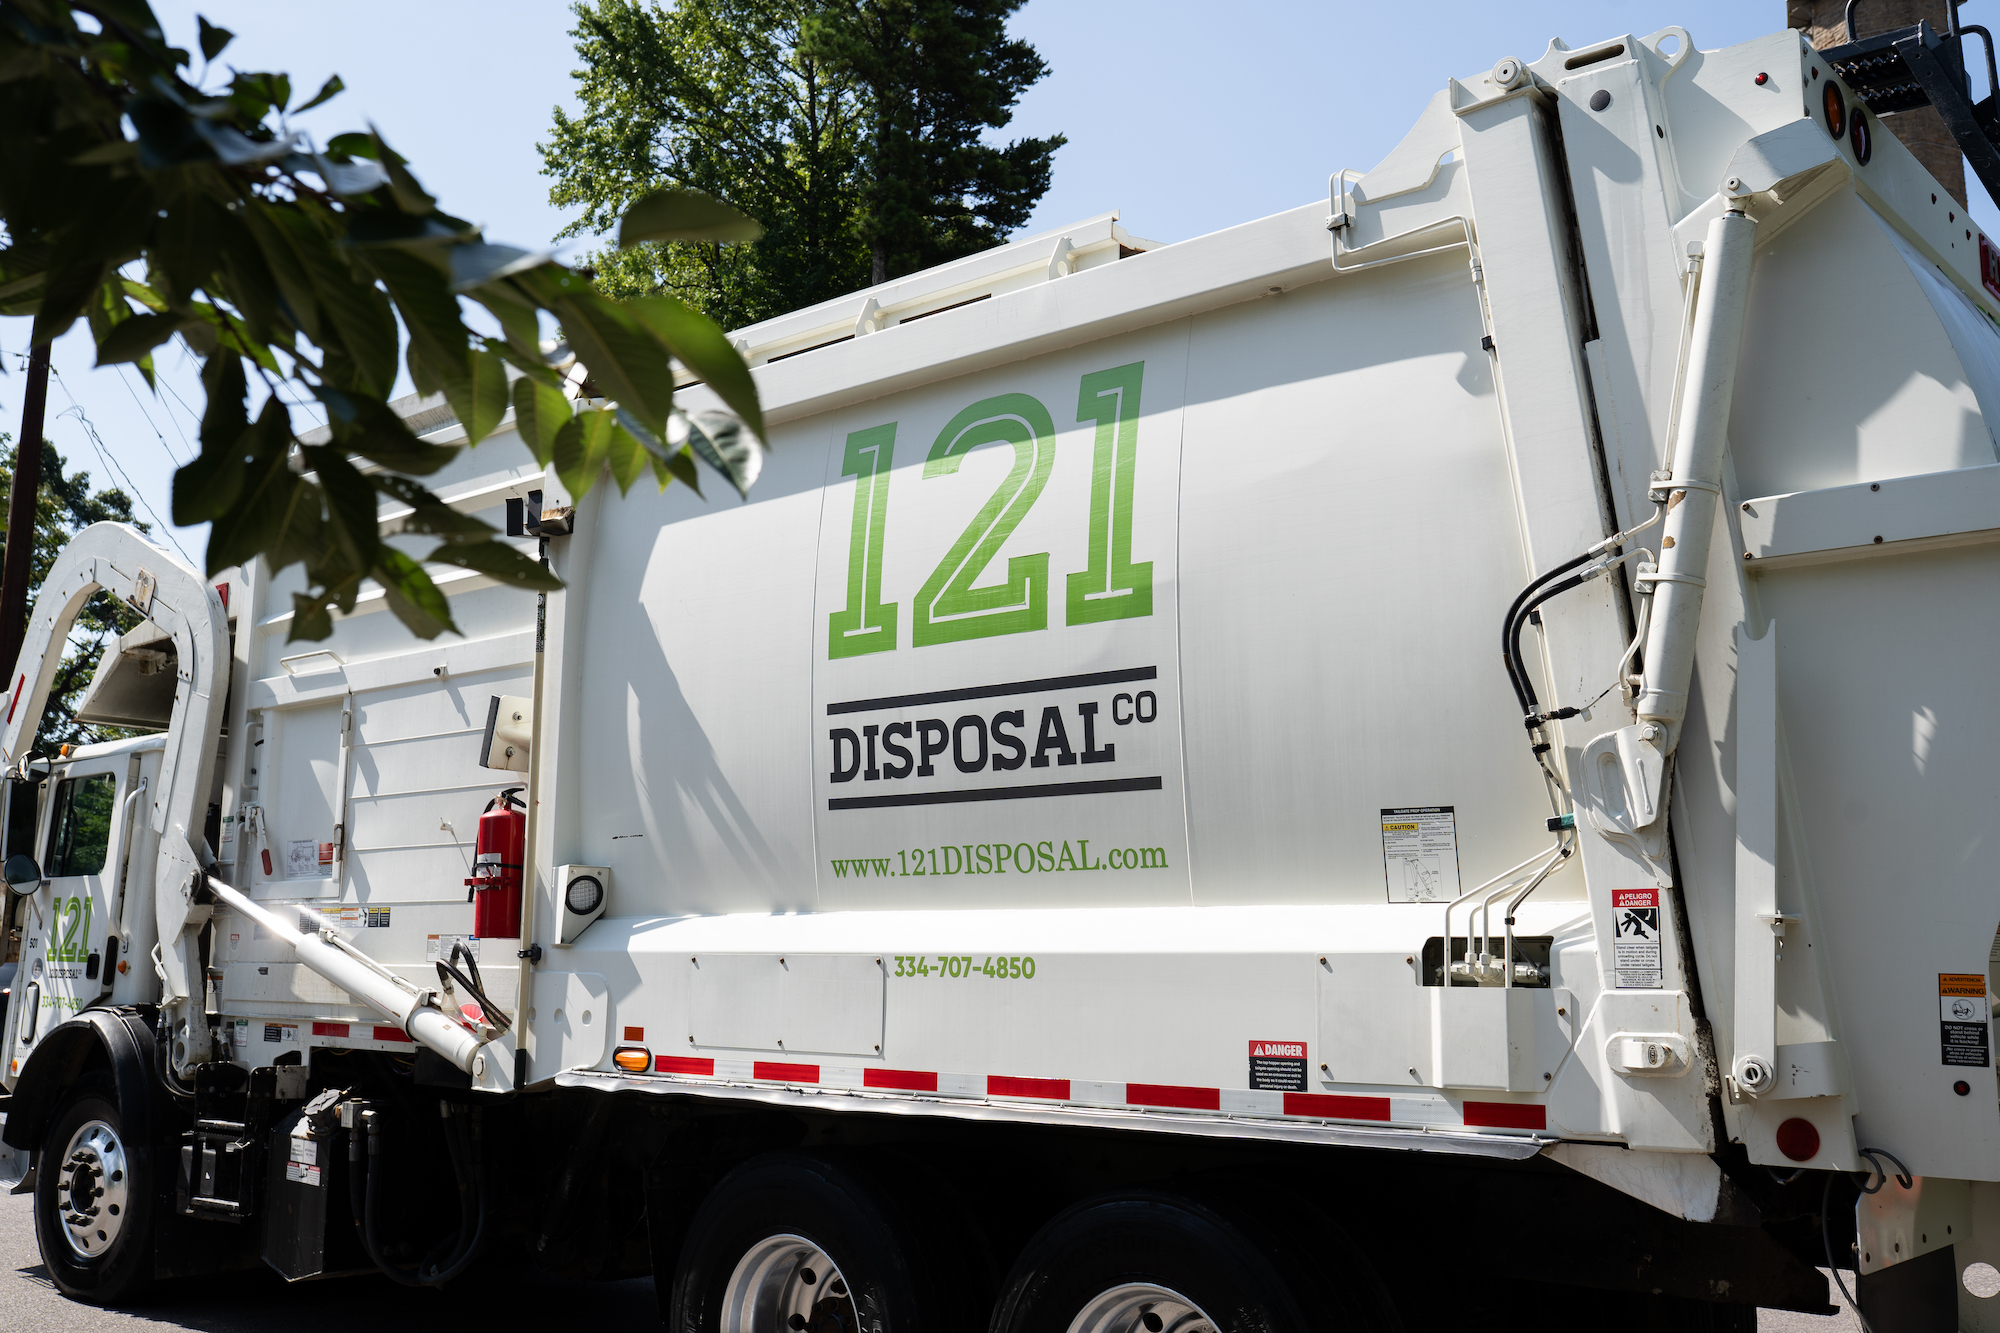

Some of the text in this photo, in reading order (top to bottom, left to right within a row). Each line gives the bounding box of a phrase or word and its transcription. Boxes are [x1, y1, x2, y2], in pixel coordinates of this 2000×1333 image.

[1988, 244, 2000, 285] H
[829, 361, 1153, 659] 121
[830, 691, 1157, 784] DISPOSAL CO
[831, 840, 1169, 878] www.121DISPOSAL.com
[47, 896, 93, 962] 121
[894, 956, 1035, 979] 334-707-4850
[42, 996, 83, 1010] 334-707-4850
[1265, 1044, 1302, 1056] DANGER
